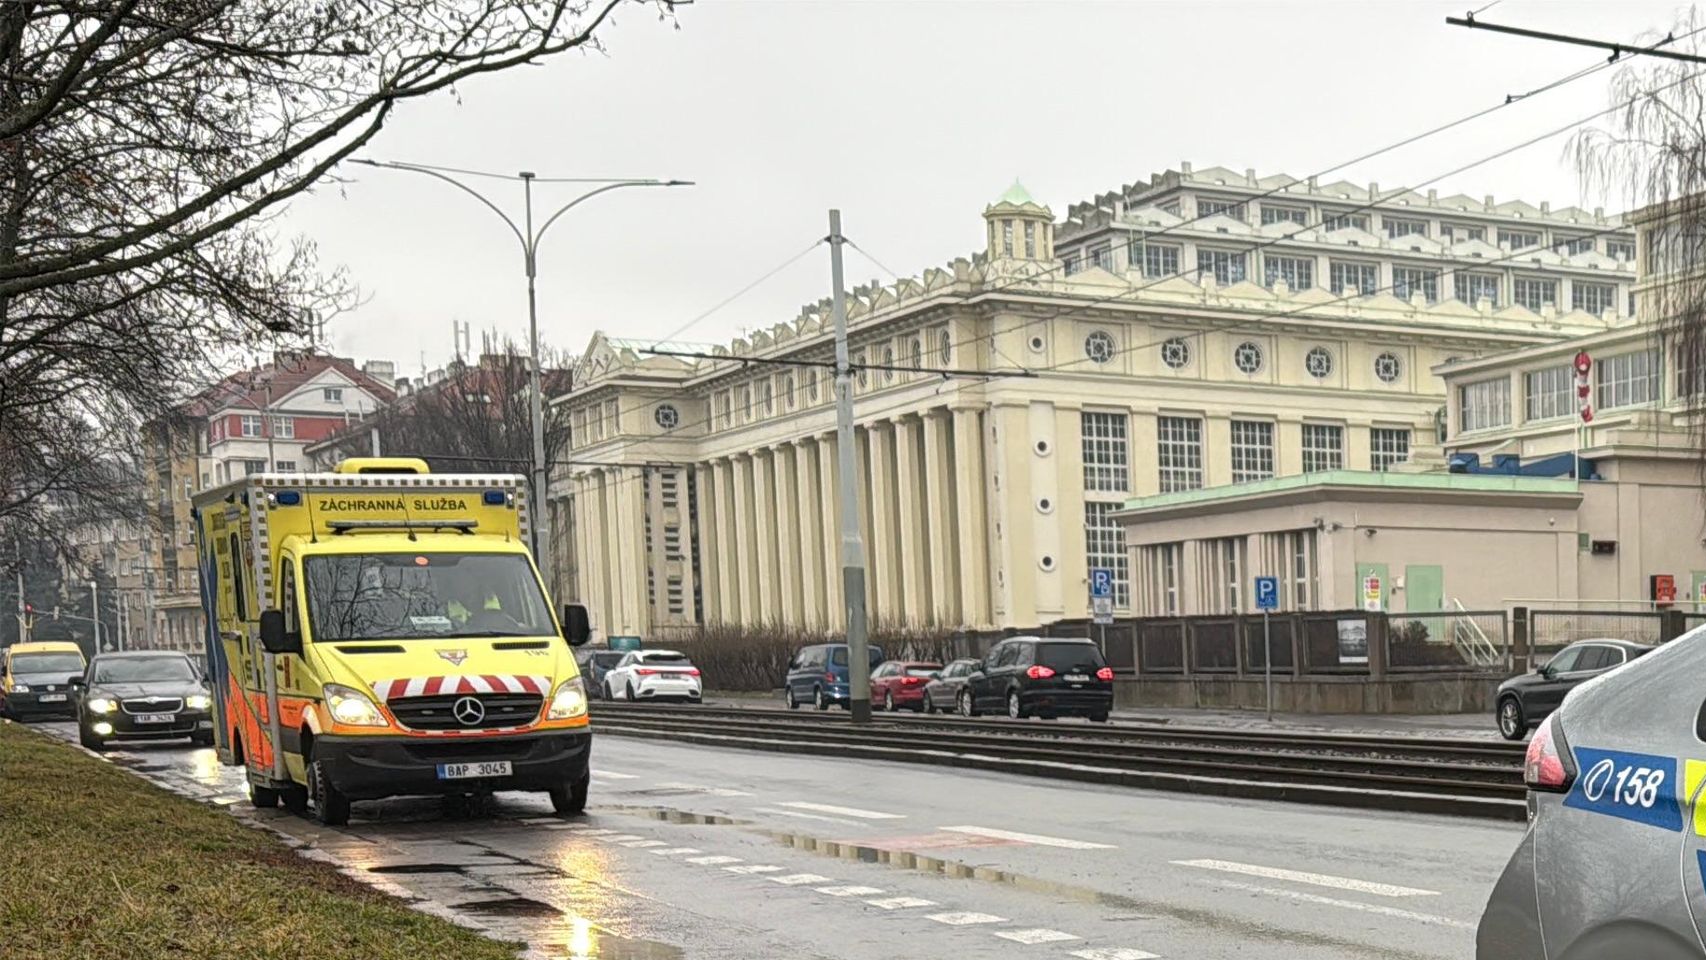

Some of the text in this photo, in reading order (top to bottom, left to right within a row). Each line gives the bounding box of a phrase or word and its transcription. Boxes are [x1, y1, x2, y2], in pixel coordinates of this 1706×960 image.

[319, 498, 467, 511] ZÁCHRANNÁ SLUŽBA
[1096, 572, 1107, 588] P
[1260, 580, 1273, 599] P
[478, 763, 507, 775] 3045
[1614, 766, 1665, 808] 158
